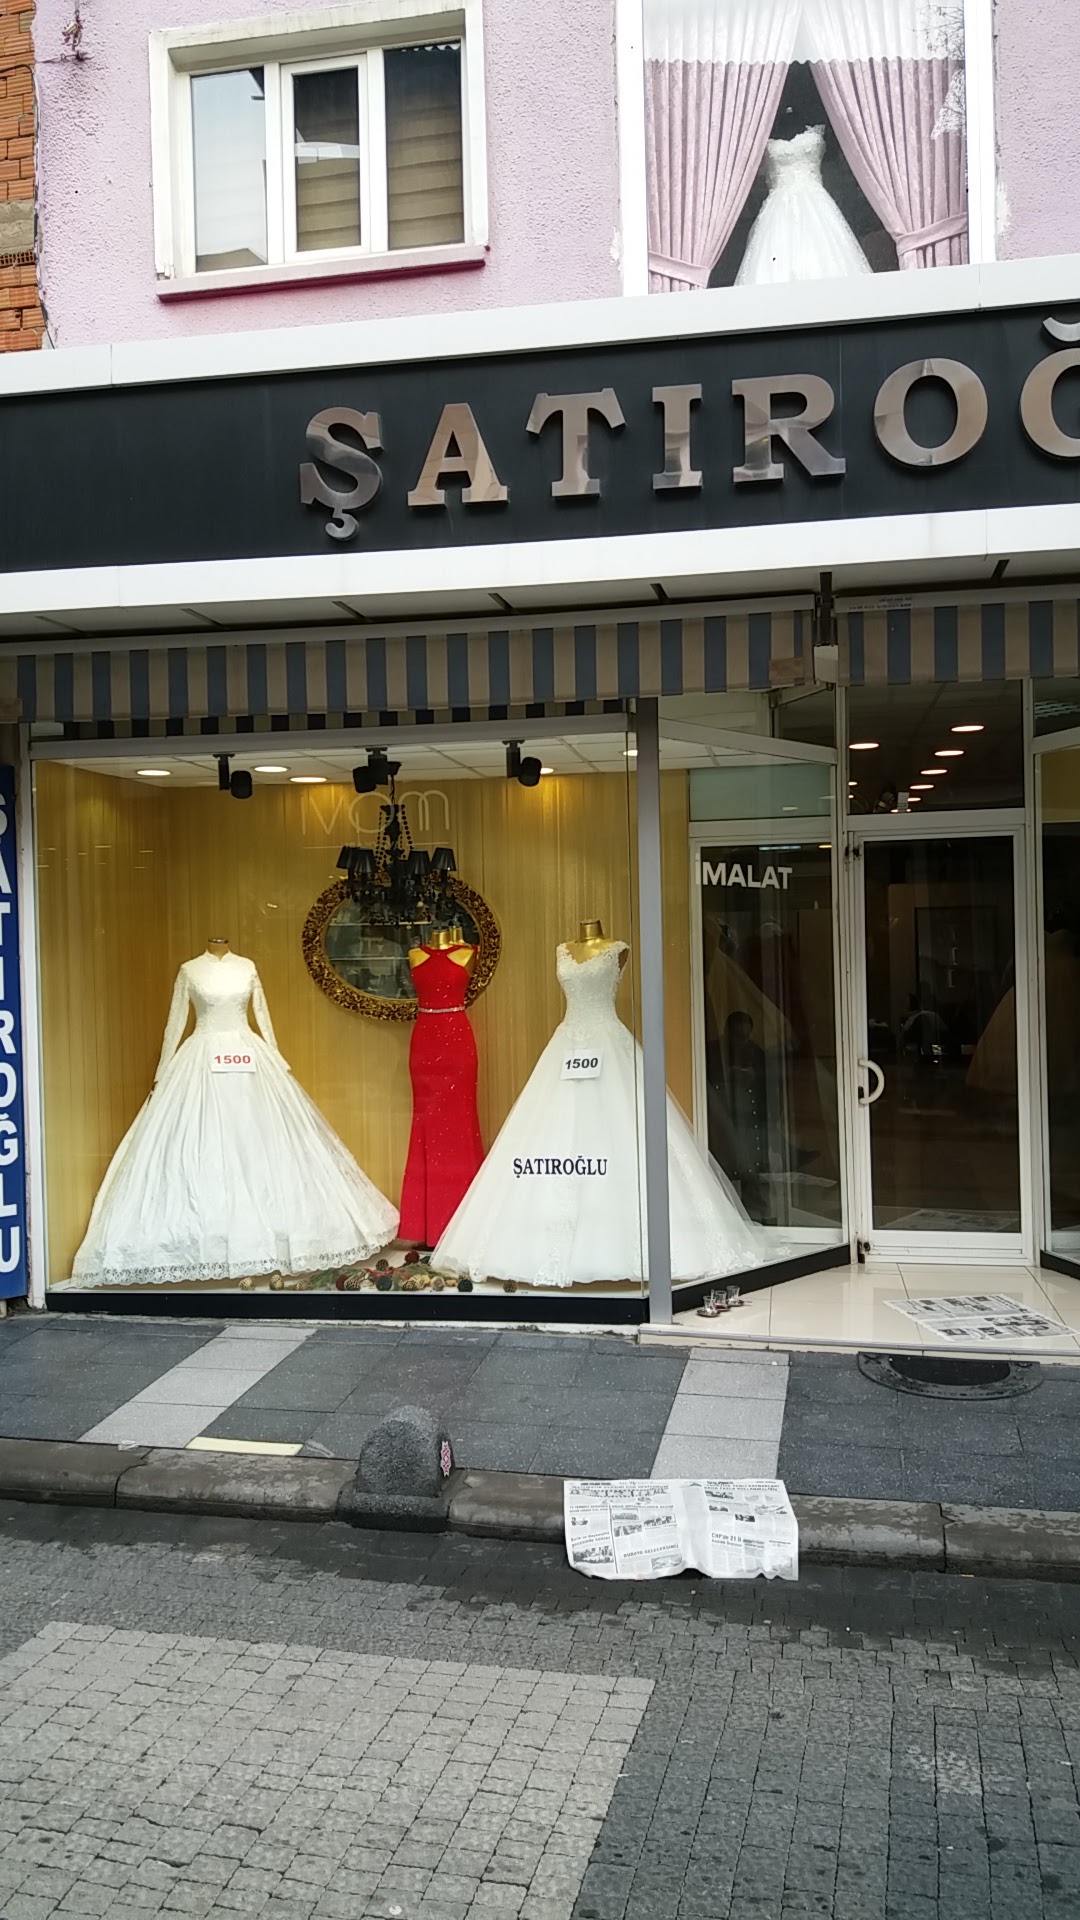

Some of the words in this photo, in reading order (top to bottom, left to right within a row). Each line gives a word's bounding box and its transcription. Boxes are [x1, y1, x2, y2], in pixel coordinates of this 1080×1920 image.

[214, 1055, 251, 1064] 1500
[565, 1057, 598, 1069] 1500
[513, 1155, 608, 1178] ŞATIROĞLU
